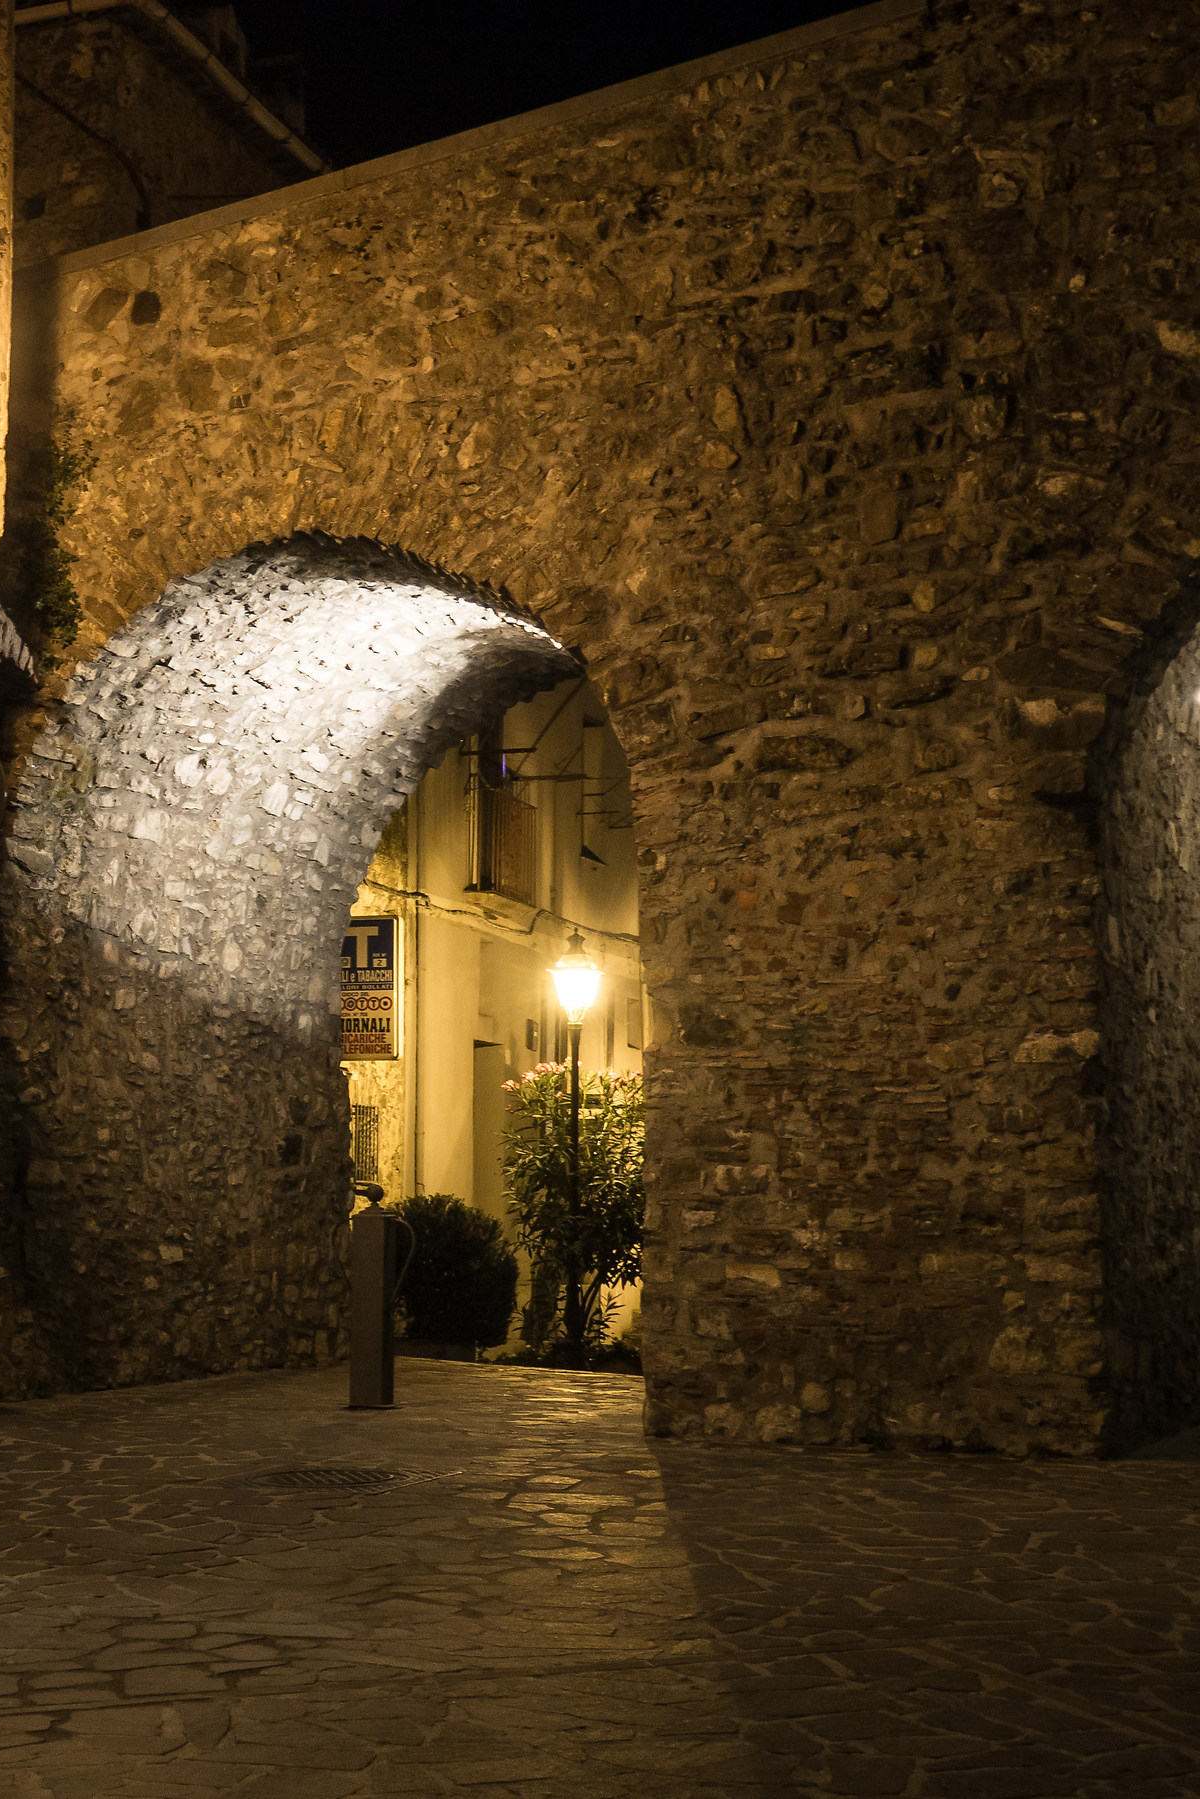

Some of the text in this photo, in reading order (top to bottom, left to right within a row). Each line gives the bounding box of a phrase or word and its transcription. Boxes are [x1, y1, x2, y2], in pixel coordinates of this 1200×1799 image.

[346, 926, 379, 968] T
[341, 969, 393, 982] LI e TABACCHI
[341, 1018, 390, 1033] IORNALI
